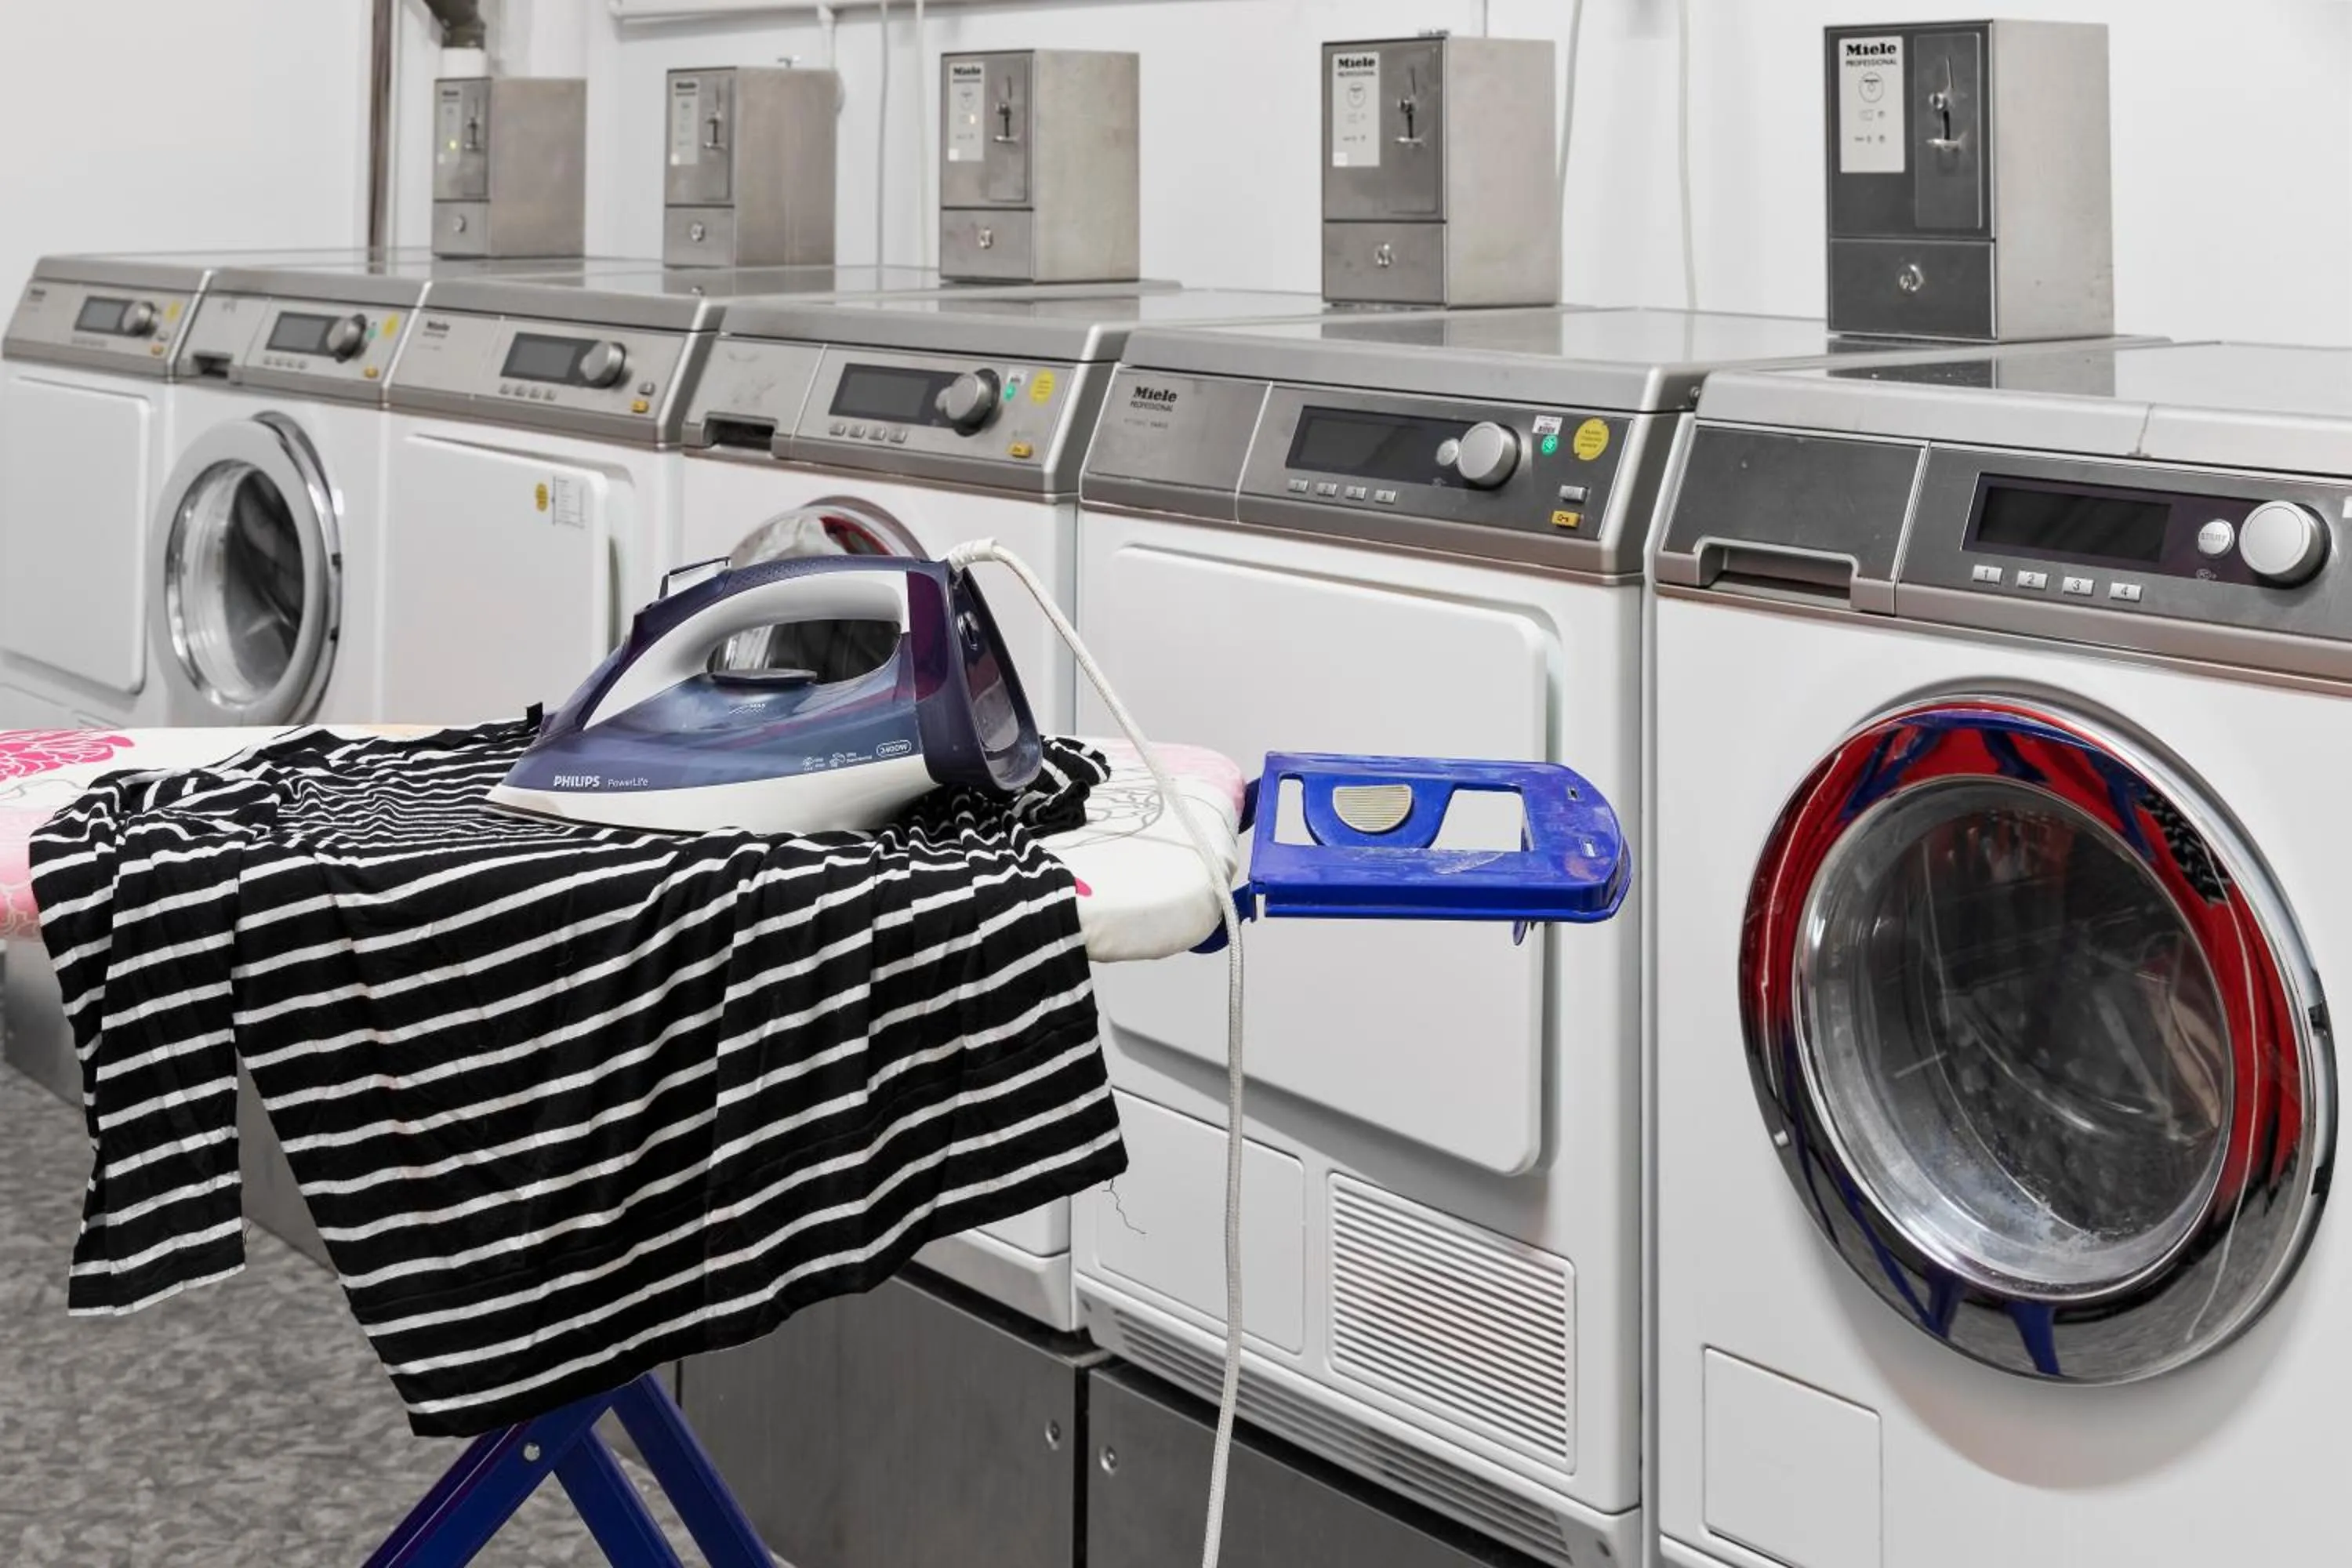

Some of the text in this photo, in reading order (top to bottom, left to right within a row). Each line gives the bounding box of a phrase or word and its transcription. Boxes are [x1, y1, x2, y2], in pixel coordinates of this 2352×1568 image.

[1846, 43, 1896, 56] Miele
[1338, 57, 1375, 68] Miele
[1134, 386, 1178, 402] Miele
[2027, 575, 2034, 584] 2
[2074, 580, 2082, 591] 3
[2122, 586, 2128, 596] 4
[554, 775, 649, 788] PHILIPS PowerLife
